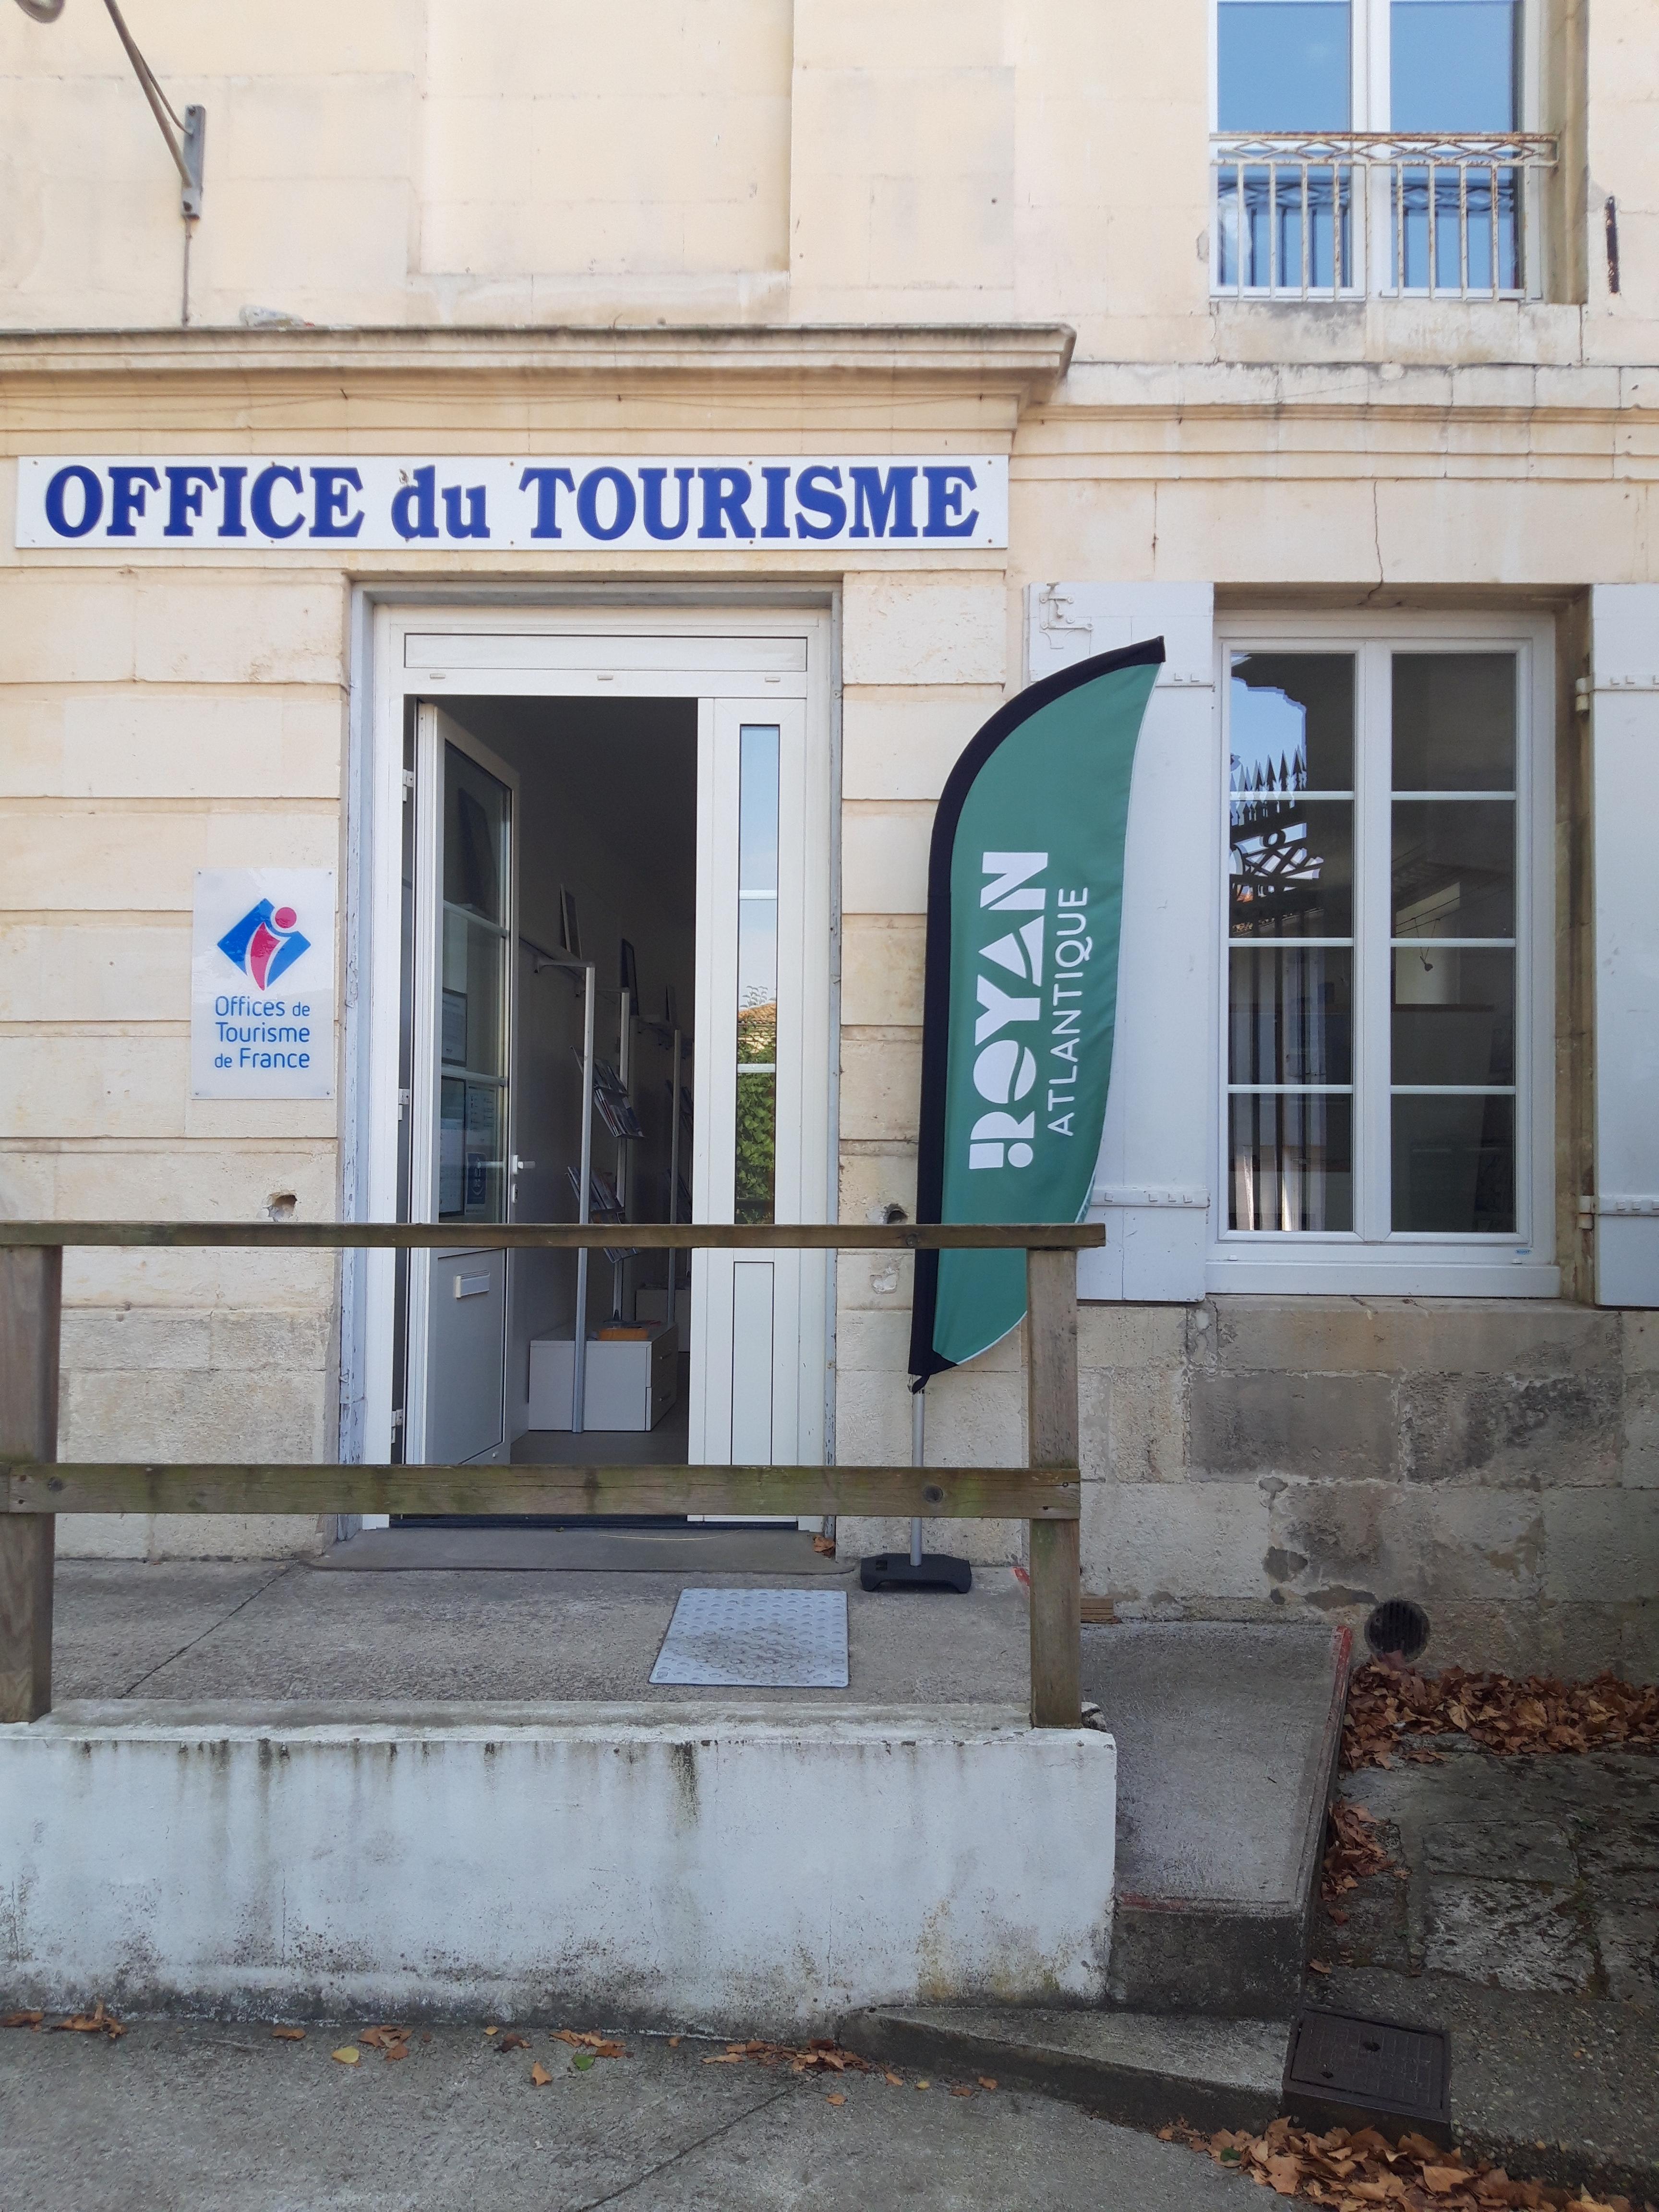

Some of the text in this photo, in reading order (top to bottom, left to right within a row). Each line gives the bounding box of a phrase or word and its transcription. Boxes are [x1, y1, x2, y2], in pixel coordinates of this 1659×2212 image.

[45, 465, 979, 540] OFFICE du TOURISME
[215, 996, 310, 1017] Offices de
[969, 852, 1048, 1169] ROYAN
[1047, 887, 1092, 1136] ATLANTIQUE
[215, 1022, 310, 1043] Tourisme
[215, 1047, 310, 1068] de France
